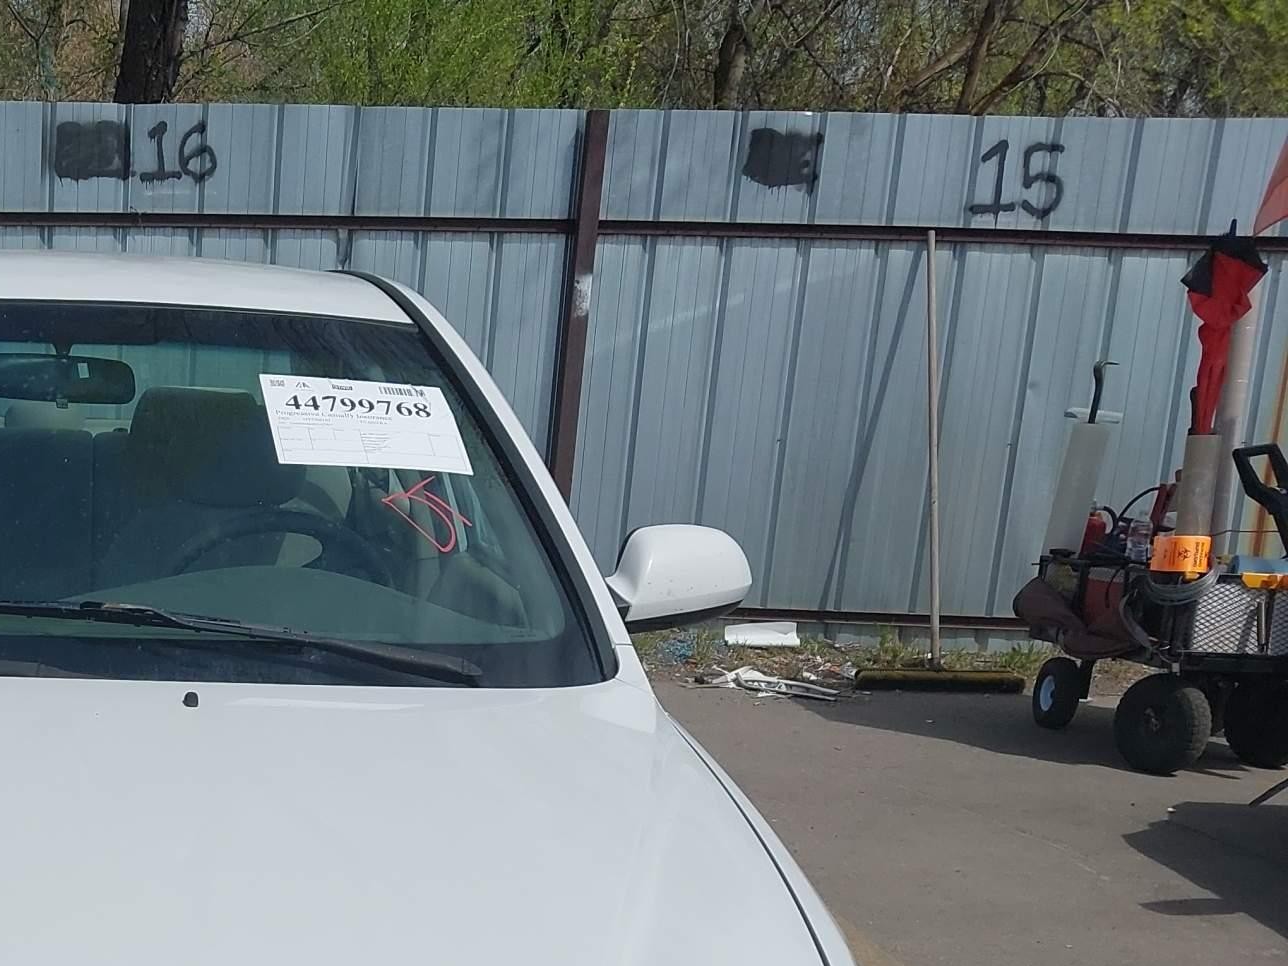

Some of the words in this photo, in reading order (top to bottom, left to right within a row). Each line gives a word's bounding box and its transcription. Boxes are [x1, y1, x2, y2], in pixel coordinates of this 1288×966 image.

[139, 120, 218, 184] 16
[968, 138, 1065, 220] 15
[285, 394, 432, 418] 44799768
